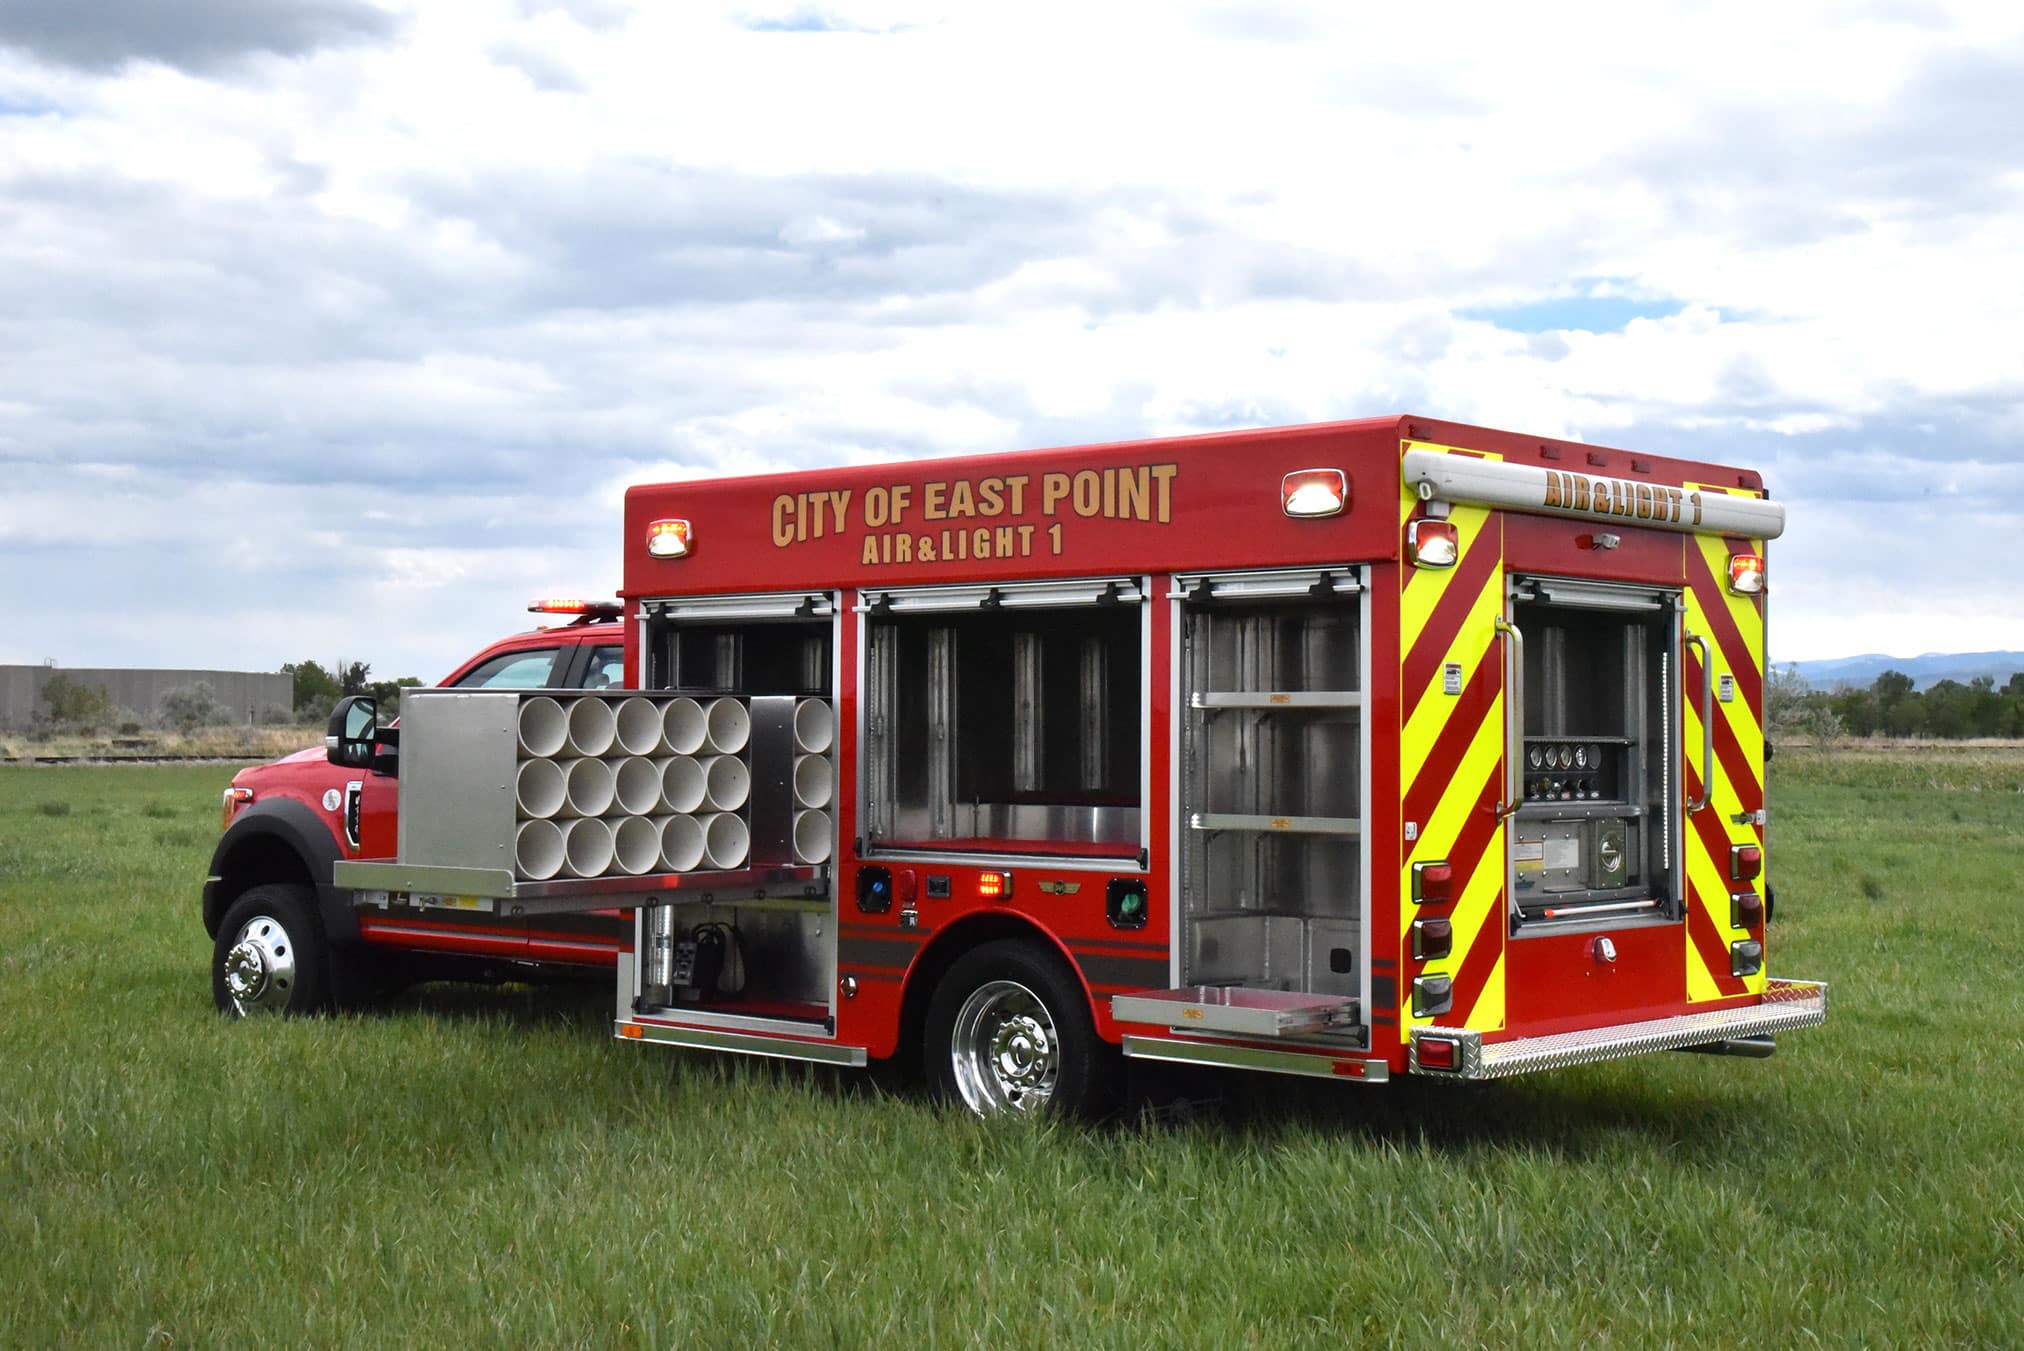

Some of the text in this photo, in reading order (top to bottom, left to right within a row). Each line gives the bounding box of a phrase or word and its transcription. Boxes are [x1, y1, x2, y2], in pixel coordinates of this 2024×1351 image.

[772, 465, 1177, 547] CITY OF EAST POINT
[1545, 472, 1702, 525] AIR&LIGHT 1
[862, 524, 1062, 565] AIR&LIGHT 1
